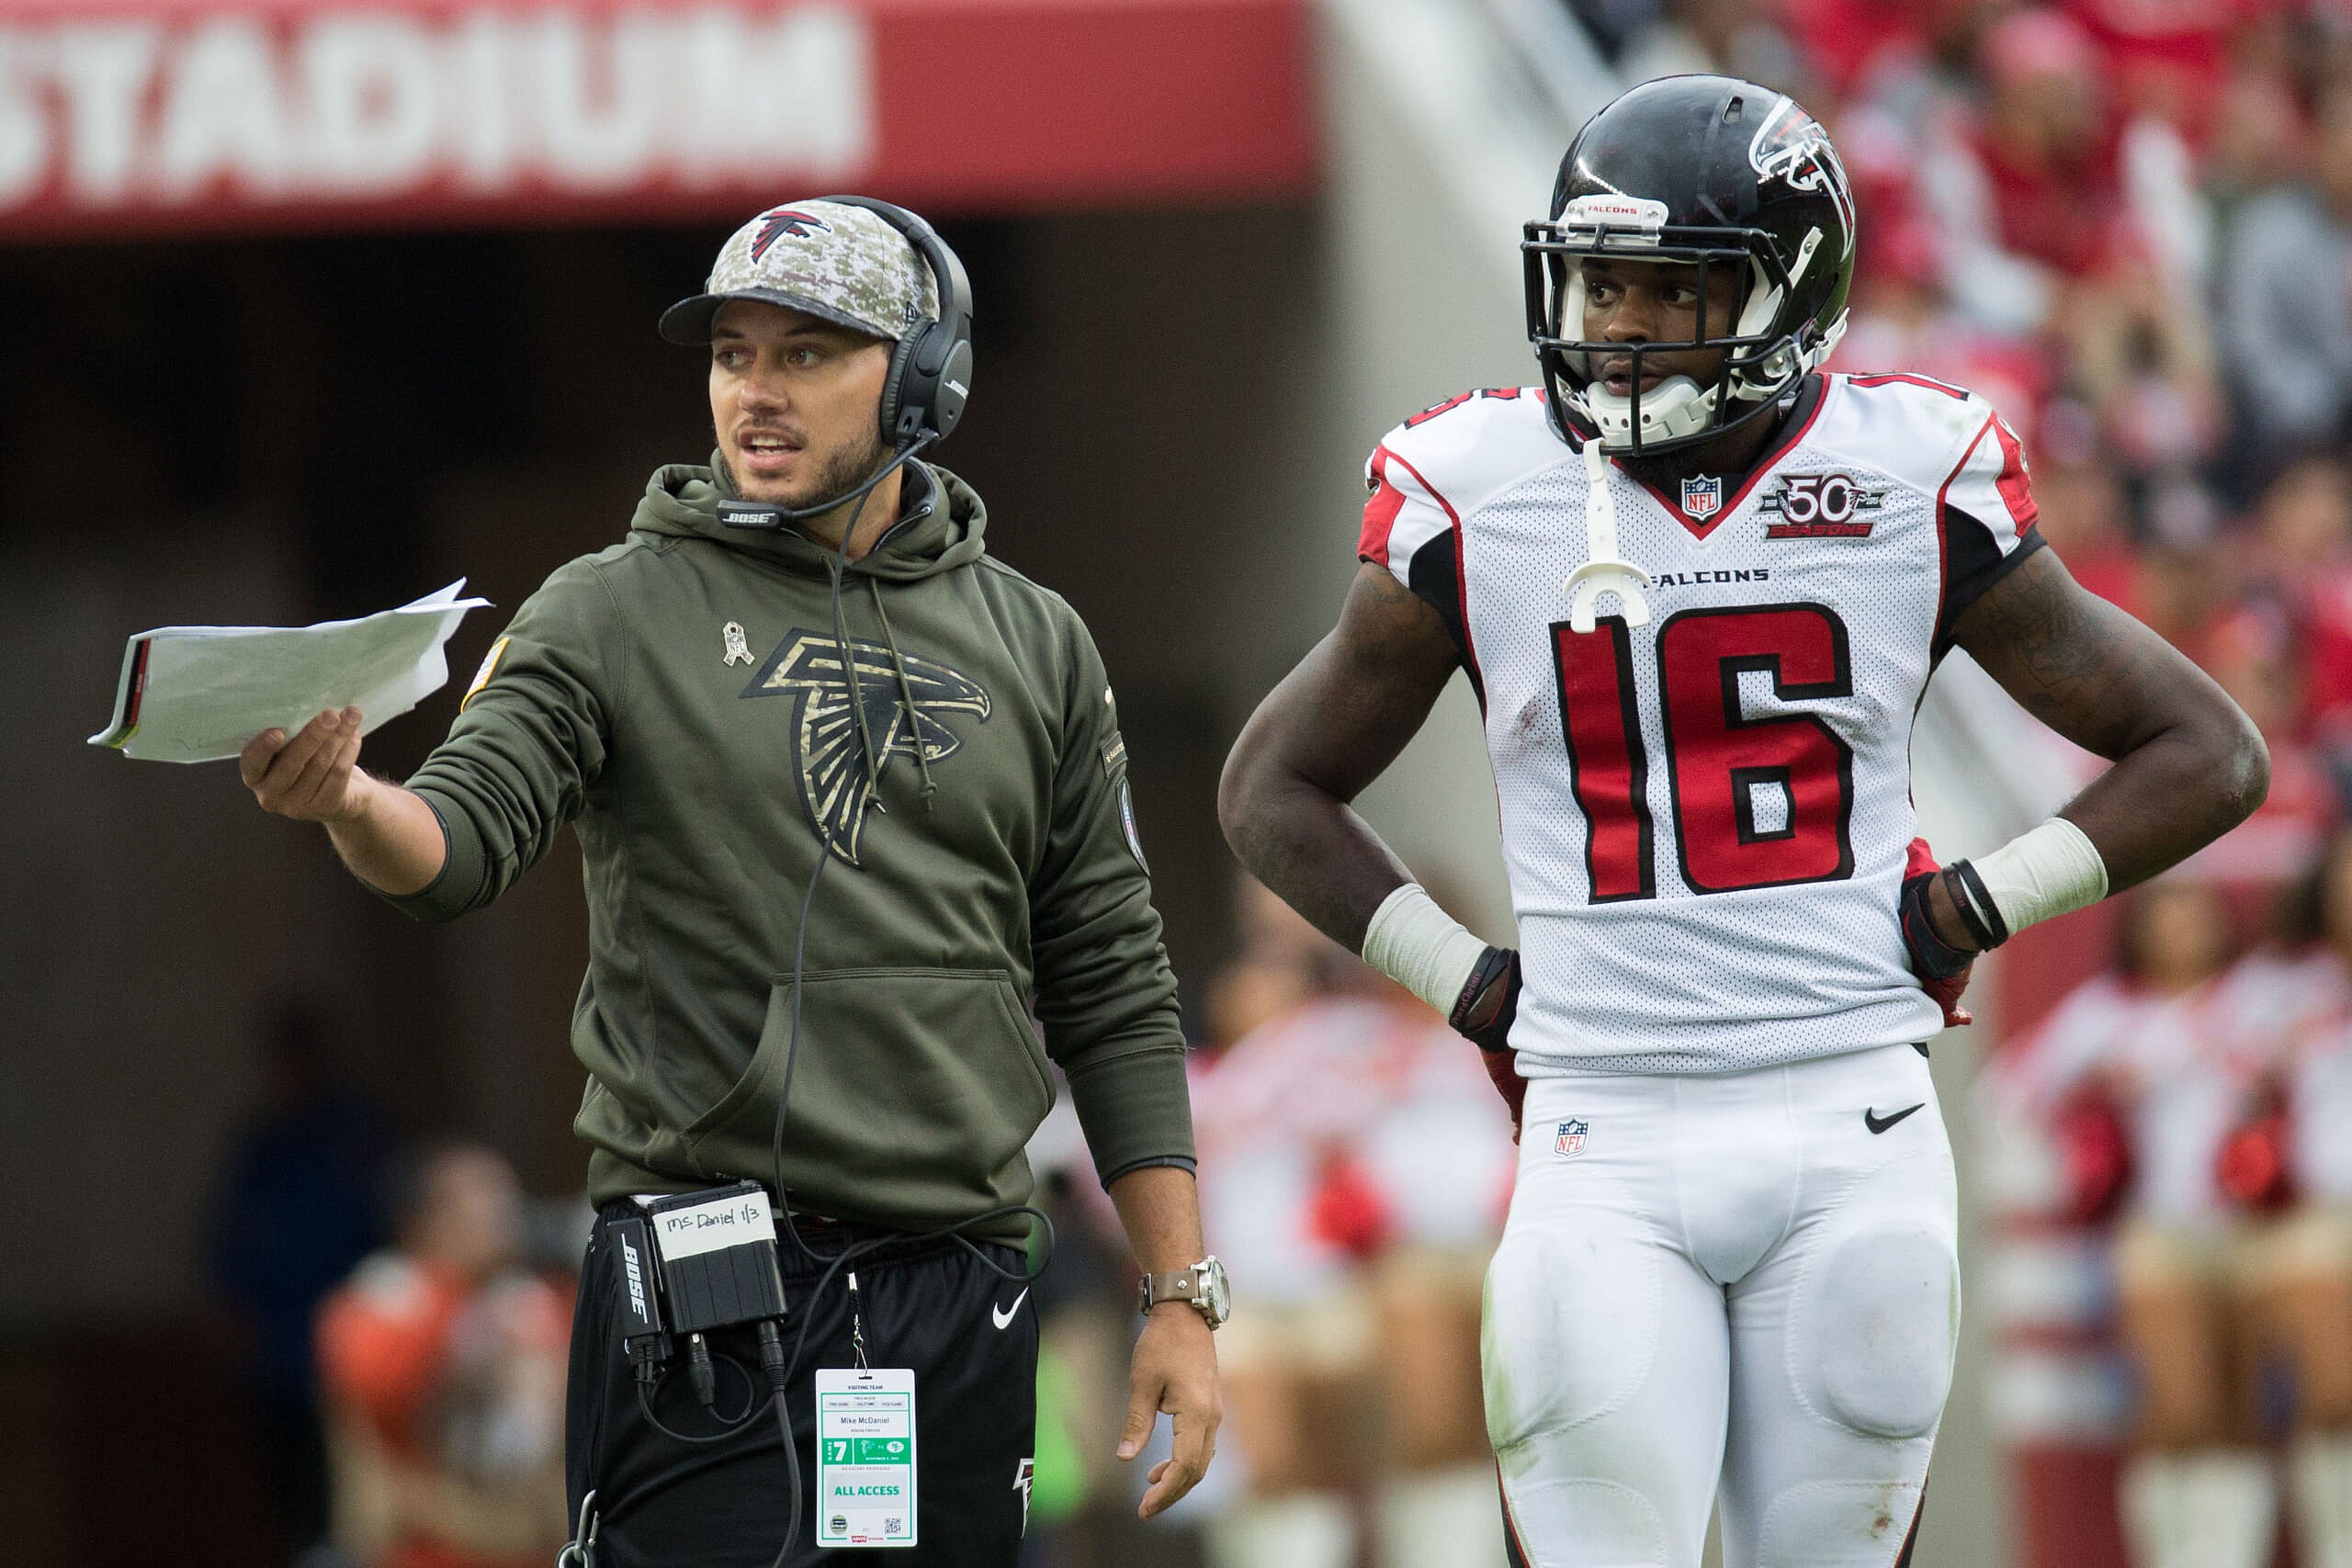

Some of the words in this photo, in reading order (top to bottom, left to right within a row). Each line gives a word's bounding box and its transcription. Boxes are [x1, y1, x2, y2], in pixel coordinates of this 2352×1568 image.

[1588, 205, 1638, 215] FALCONS
[1687, 493, 1715, 512] NFL
[1784, 475, 1855, 524] 50
[721, 513, 776, 524] BOSE
[1769, 524, 1871, 537] SEASONS
[1549, 602, 1855, 905] 16
[1557, 1135, 1582, 1153] NFL
[741, 1203, 759, 1224] 1/3
[621, 1233, 649, 1324] BOSE
[833, 1441, 847, 1461] 7
[834, 1486, 855, 1495] ALL
[857, 1485, 899, 1495] ACCESS
